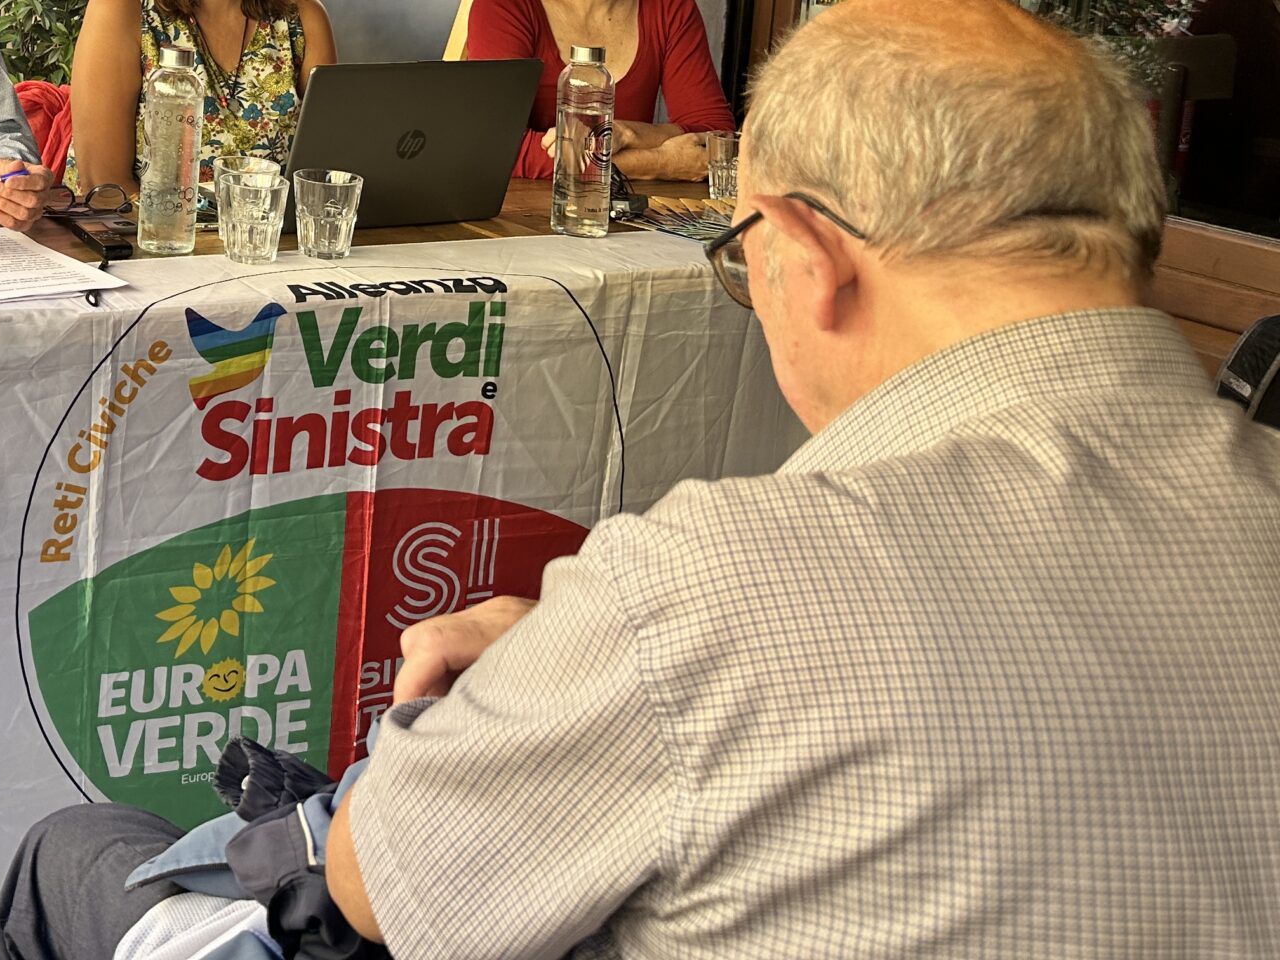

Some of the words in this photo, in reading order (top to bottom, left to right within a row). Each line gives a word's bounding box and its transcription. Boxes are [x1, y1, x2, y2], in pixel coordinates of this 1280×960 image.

[287, 276, 507, 303] Alleanza
[296, 301, 506, 388] Verdi
[481, 381, 497, 399] e
[40, 482, 87, 563] Reti
[67, 339, 173, 474] Civiche
[196, 389, 494, 481] Sinistra
[97, 699, 311, 778] VERDE
